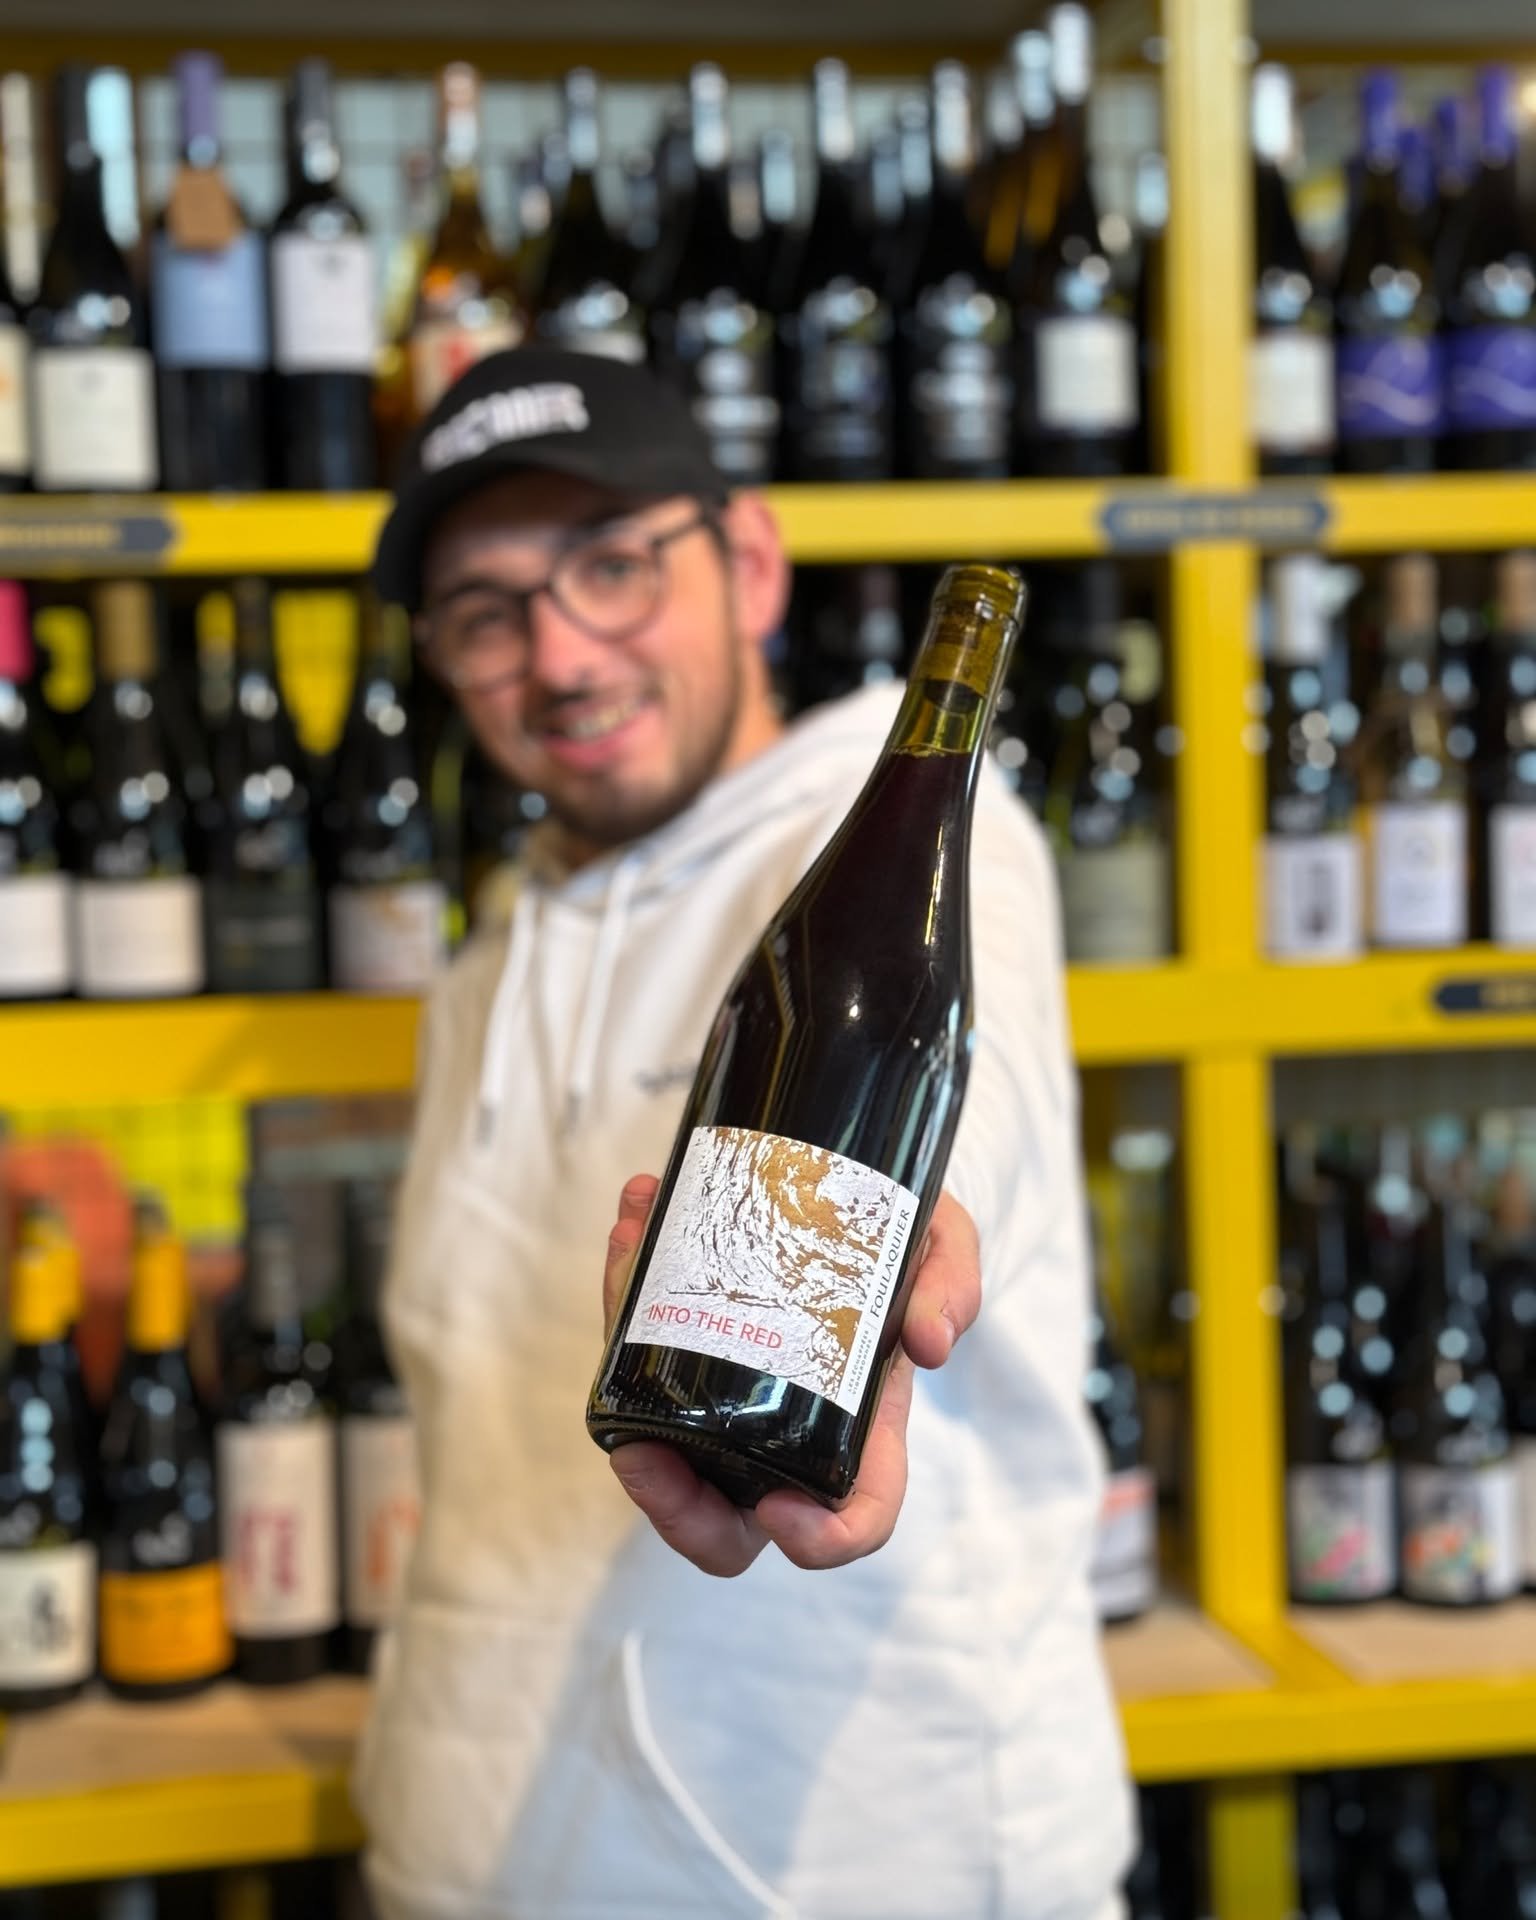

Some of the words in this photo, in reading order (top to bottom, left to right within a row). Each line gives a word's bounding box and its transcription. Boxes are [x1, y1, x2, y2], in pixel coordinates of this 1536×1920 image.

[870, 1209, 910, 1318] FOULAQUIER
[648, 1304, 691, 1324] INTO
[697, 1310, 736, 1336] THE
[740, 1322, 783, 1349] RED
